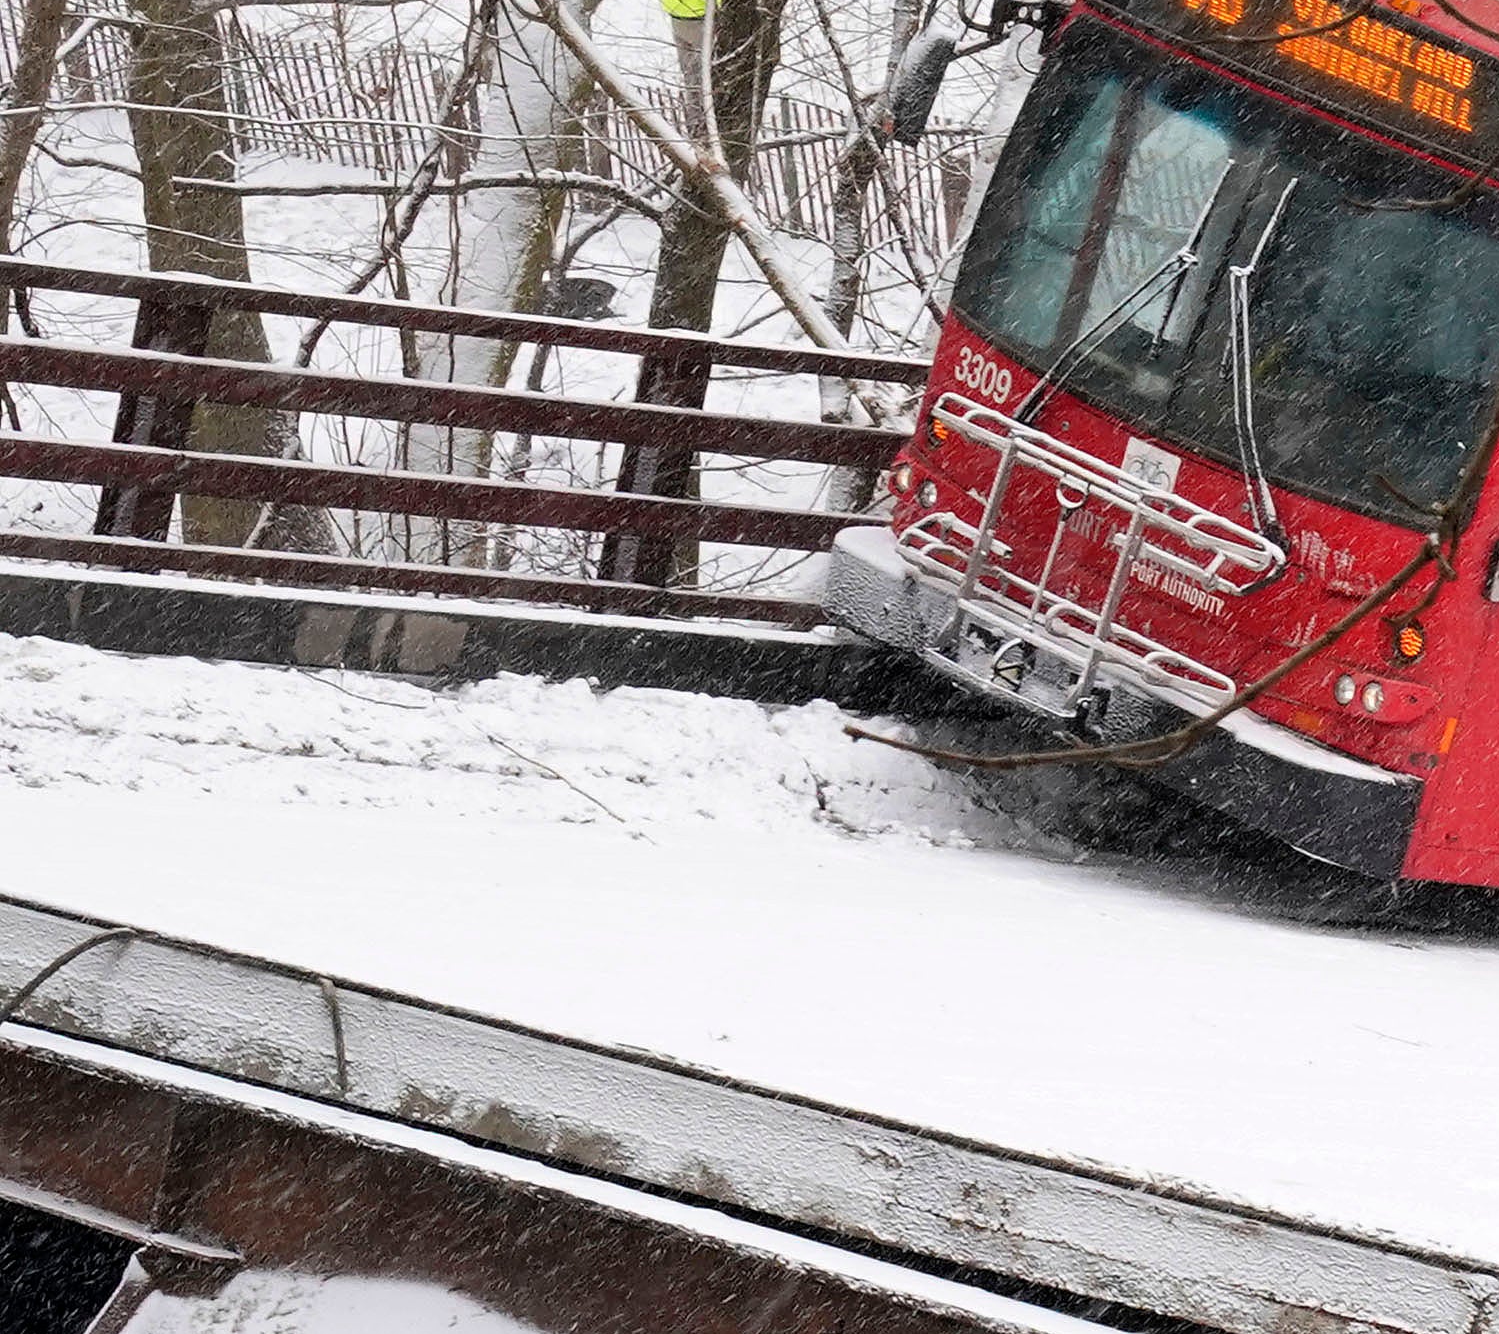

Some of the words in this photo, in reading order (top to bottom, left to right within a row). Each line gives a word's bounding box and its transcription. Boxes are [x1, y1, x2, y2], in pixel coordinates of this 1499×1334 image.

[1350, 16, 1472, 90] OAKLAND
[1411, 80, 1472, 133] HILL
[954, 346, 1012, 404] 3309
[1130, 560, 1162, 589] PORT
[1161, 571, 1224, 615] AUTHORITY
